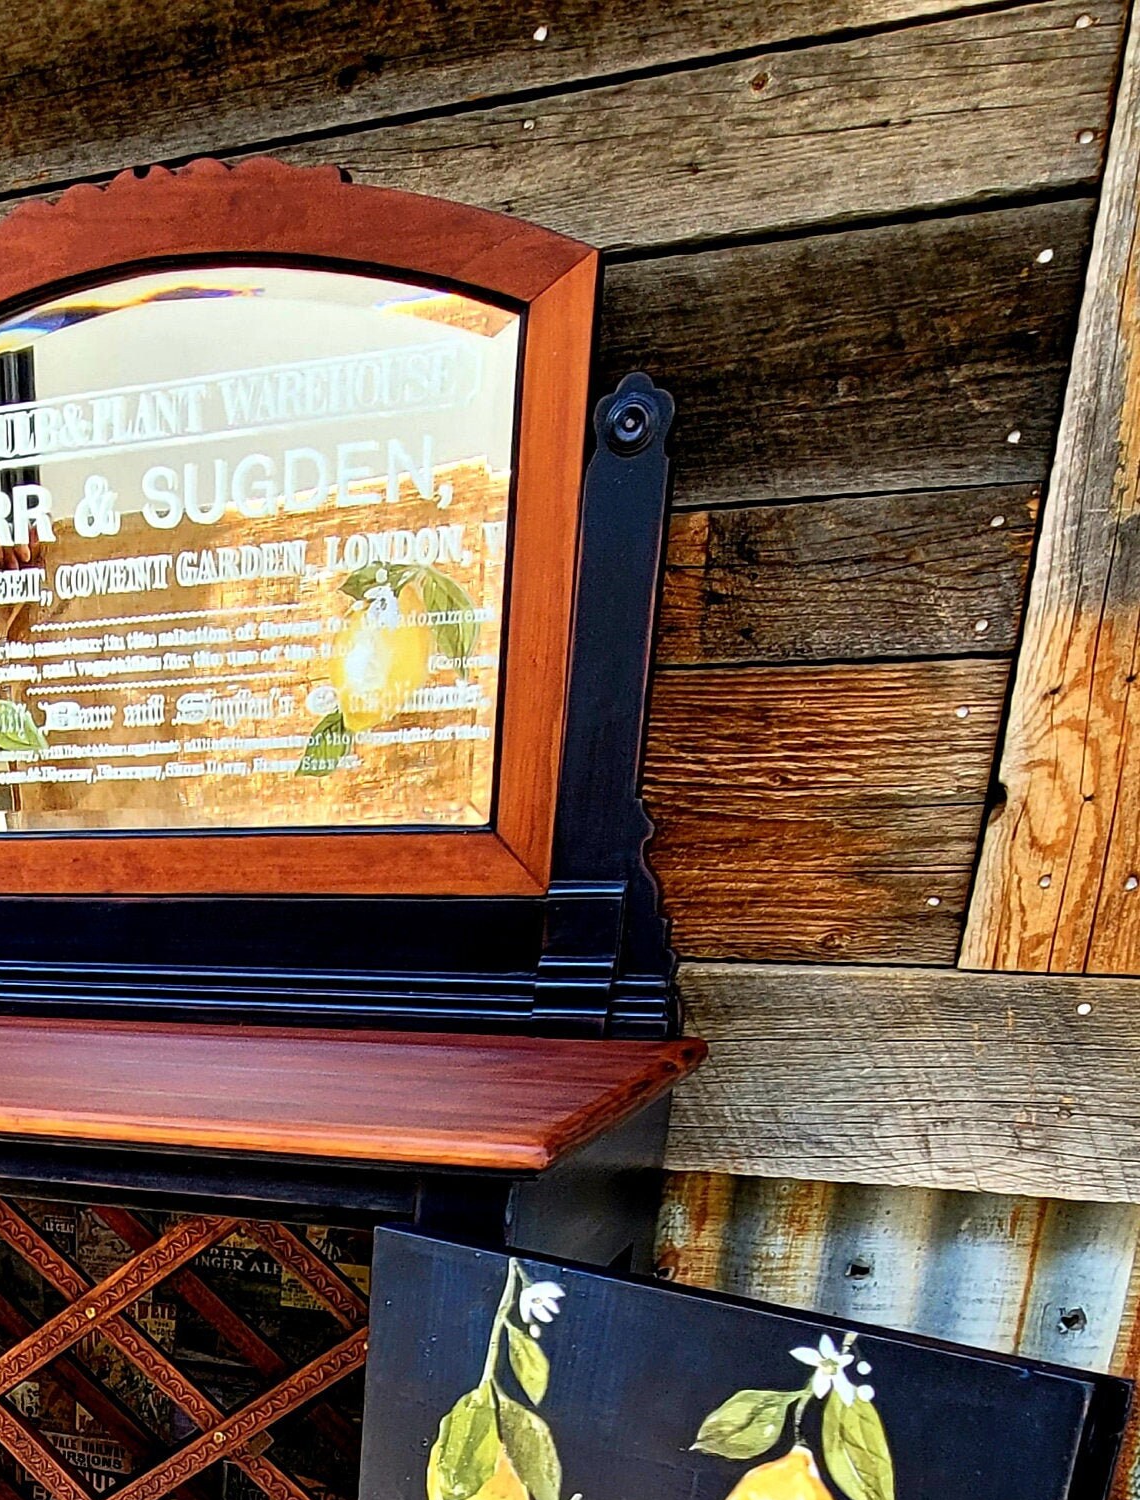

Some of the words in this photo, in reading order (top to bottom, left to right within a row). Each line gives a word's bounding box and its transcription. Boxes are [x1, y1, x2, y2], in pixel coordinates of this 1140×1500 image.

[218, 349, 456, 426] WAREHOUSE
[74, 475, 121, 538] &
[141, 434, 454, 530] SUGDEN,
[54, 554, 174, 600] COVENT
[194, 1256, 246, 1272] INGER
